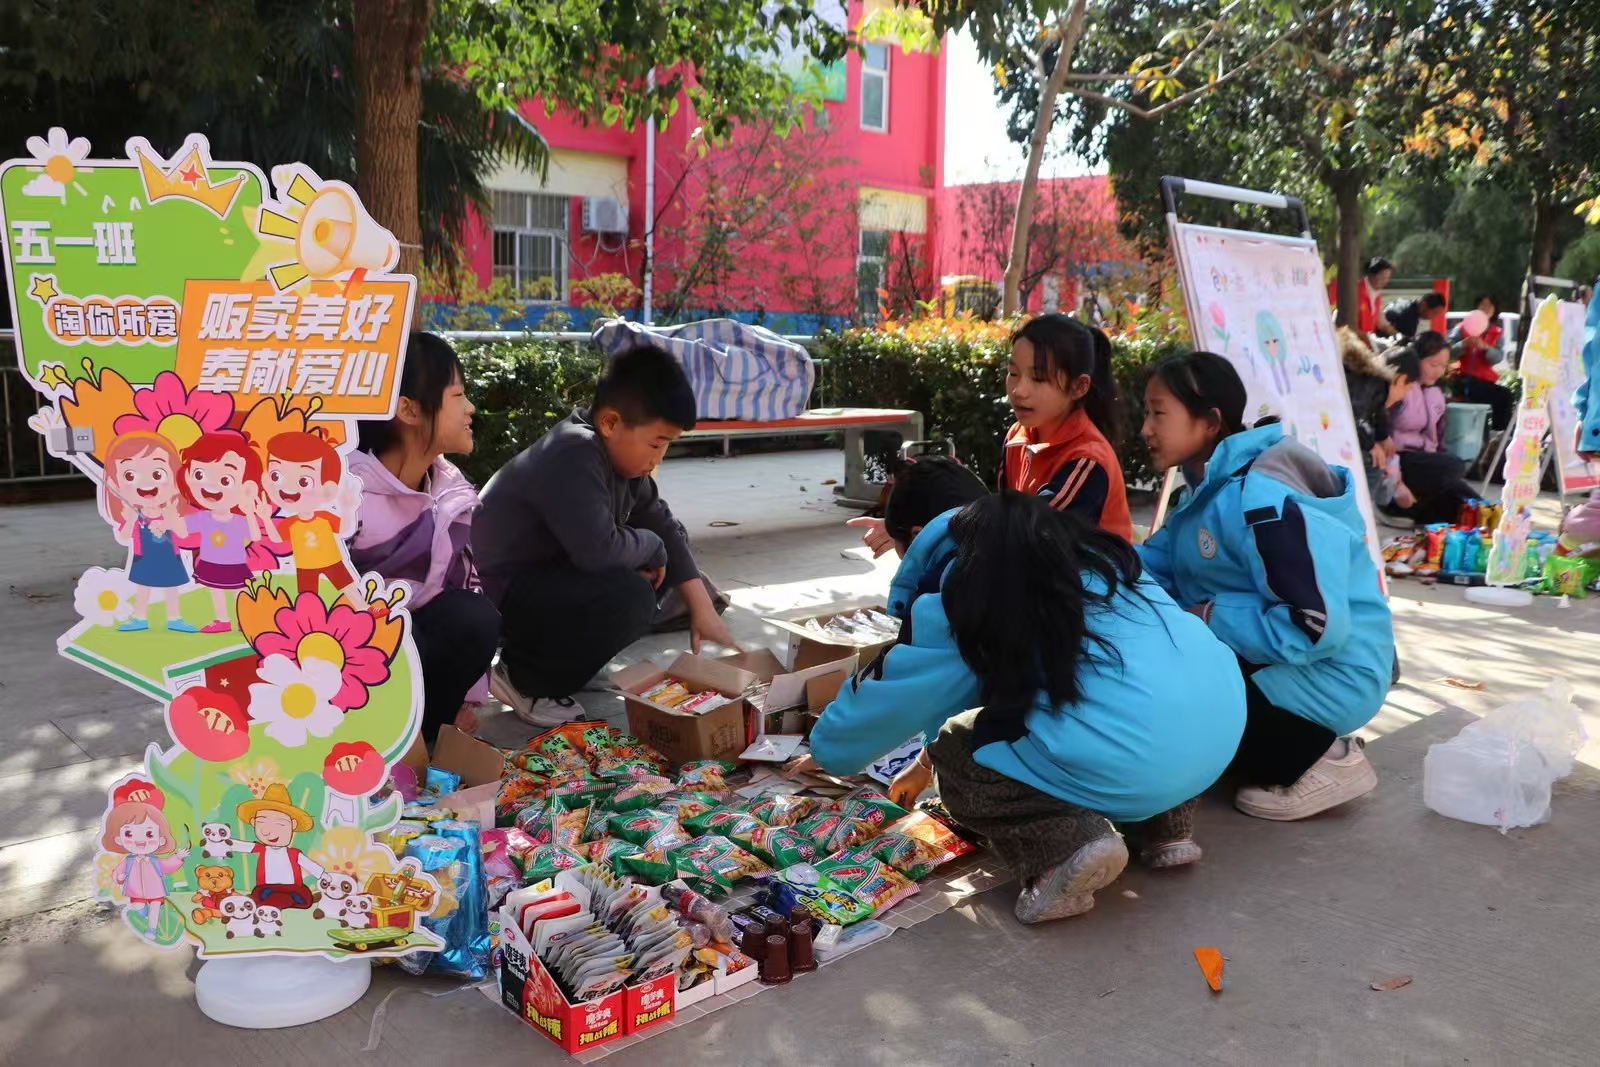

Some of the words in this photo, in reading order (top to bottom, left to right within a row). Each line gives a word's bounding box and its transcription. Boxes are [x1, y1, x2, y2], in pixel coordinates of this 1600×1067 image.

[11, 220, 137, 264] 五一班
[53, 303, 178, 337] 淘你所爱
[198, 293, 395, 342] 贩卖美好
[197, 347, 390, 396] 奉献爱心
